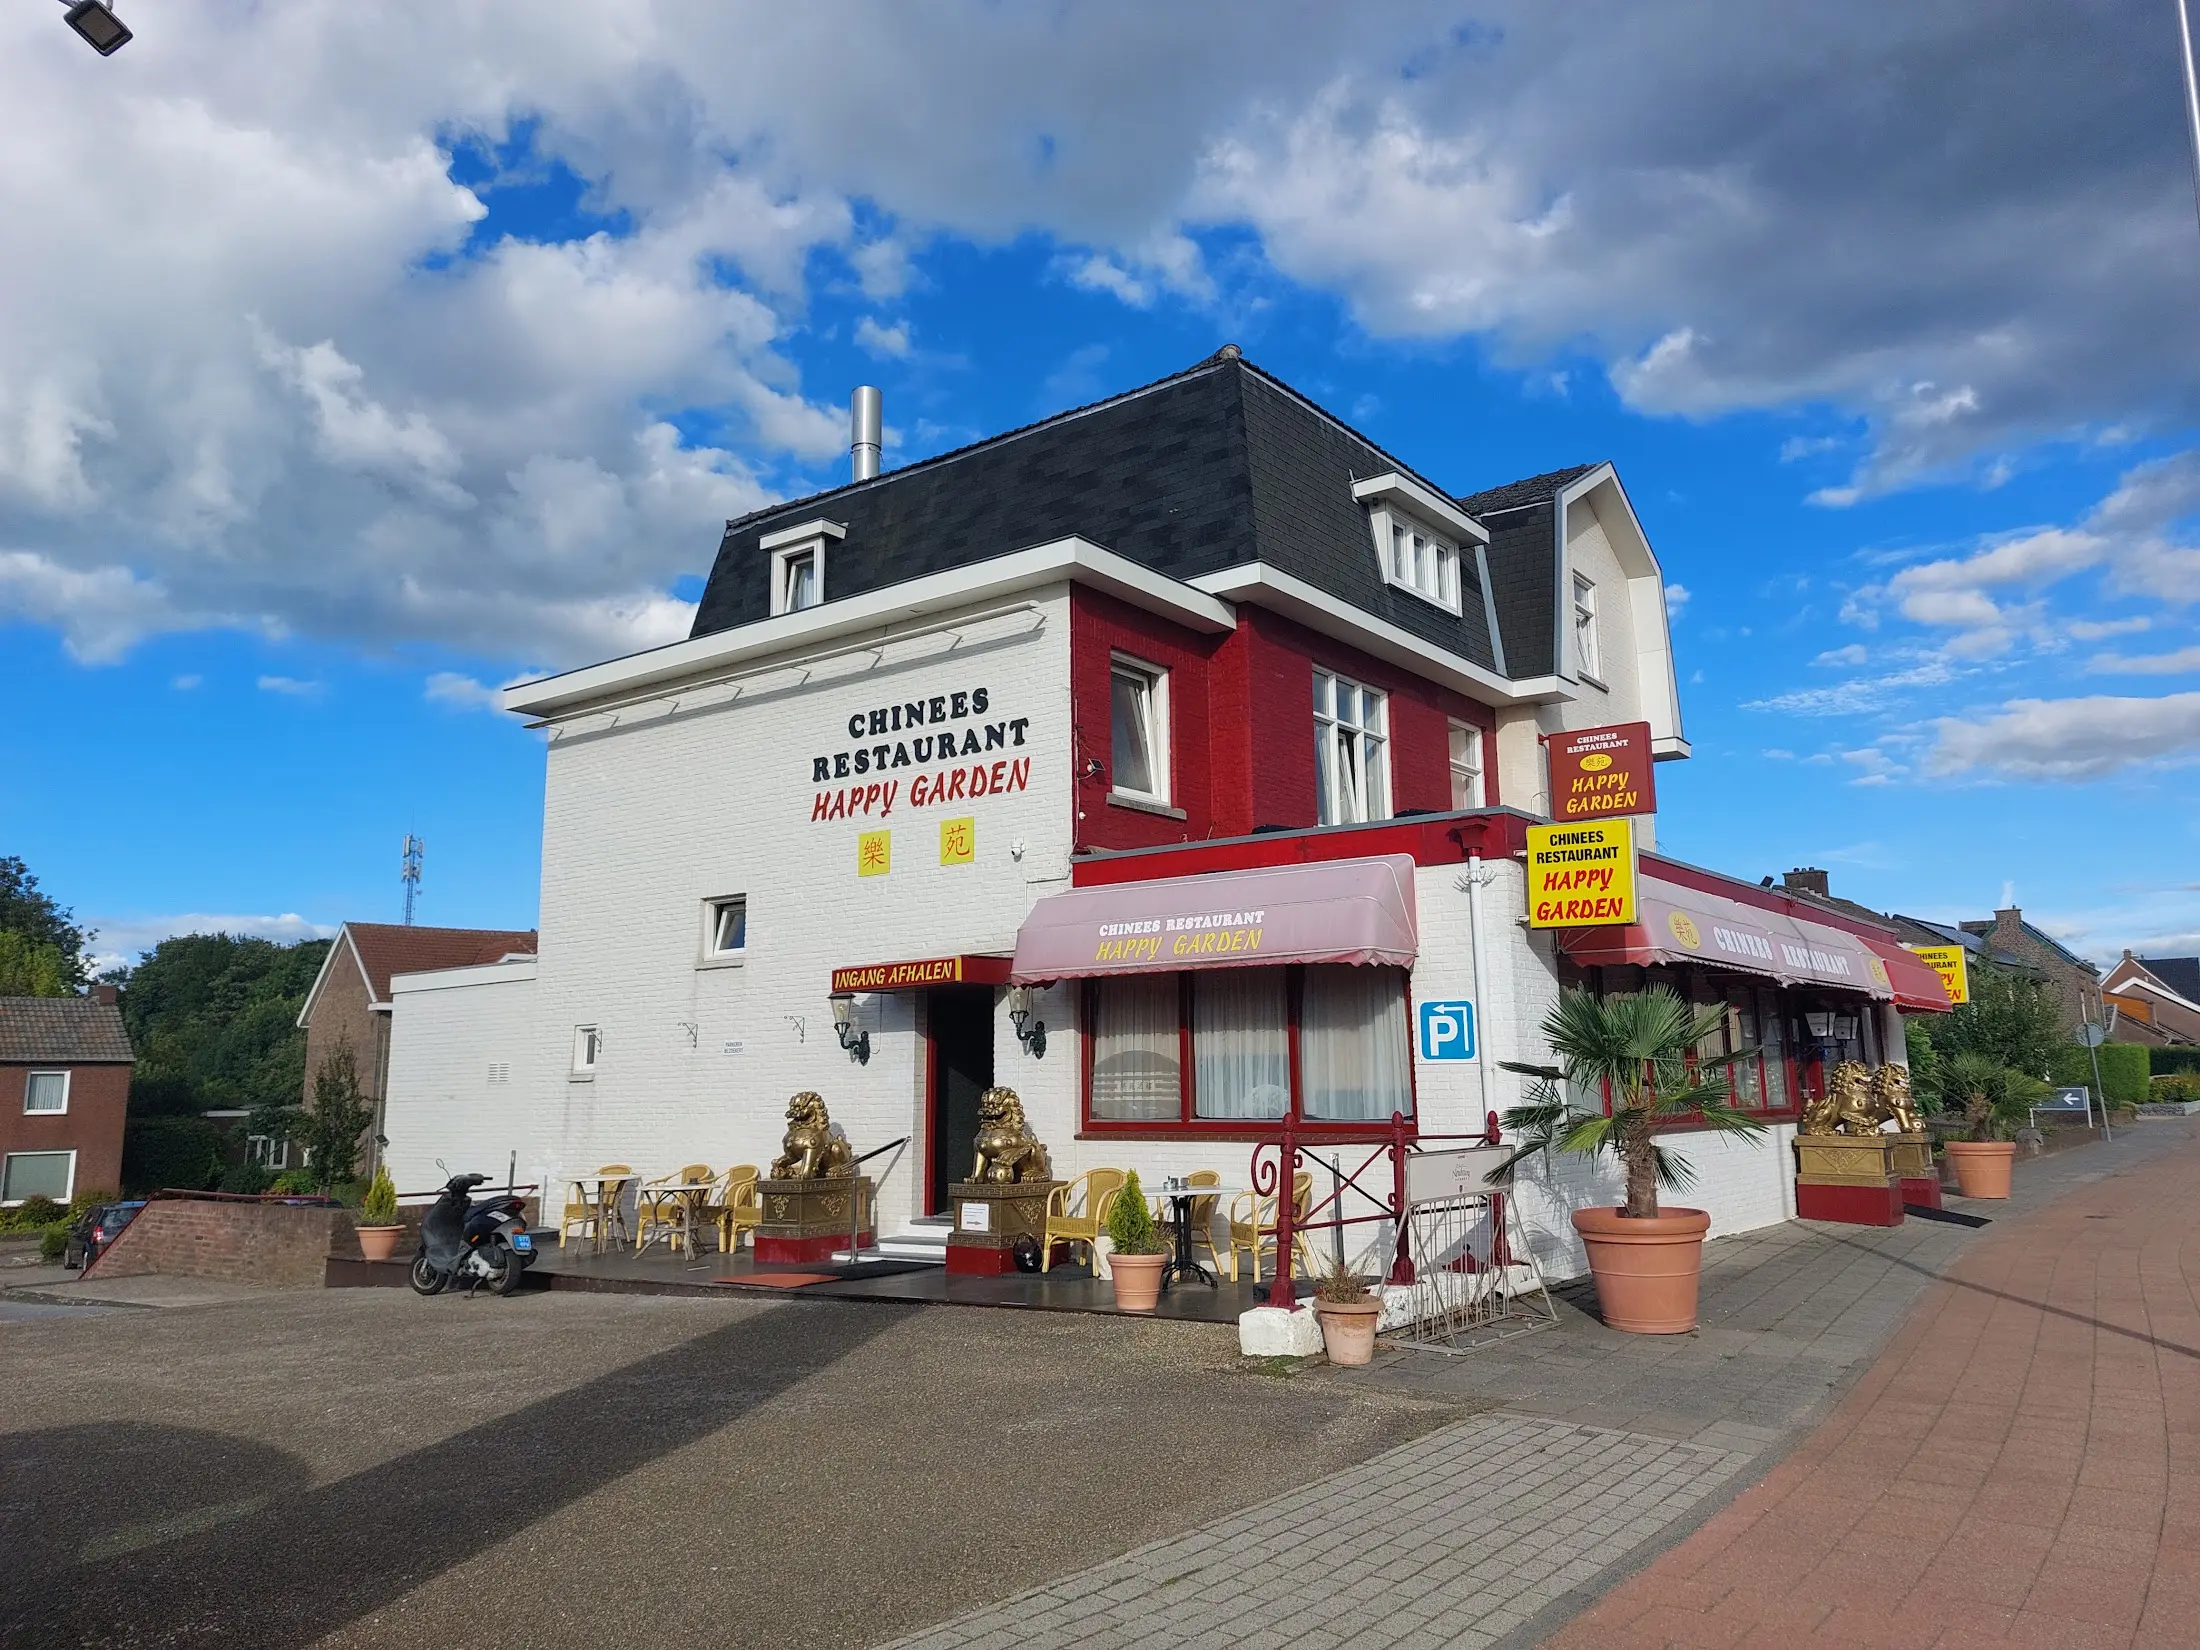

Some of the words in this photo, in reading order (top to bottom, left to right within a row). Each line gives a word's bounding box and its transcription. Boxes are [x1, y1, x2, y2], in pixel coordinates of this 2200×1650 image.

[848, 687, 989, 739] CHINEES
[812, 717, 1029, 782] RESTAURANT
[1566, 739, 1629, 754] RESTAURANT
[1576, 732, 1618, 744] CHINEES
[811, 779, 898, 822] HAPPY
[910, 756, 1030, 808] GARDEN
[1571, 771, 1629, 793] HAPPY
[1565, 791, 1637, 814] GARDEN
[863, 837, 885, 869] 樂
[944, 824, 970, 858] 苑
[1549, 830, 1604, 847] CHINEES
[1536, 846, 1619, 864] RESTAURANT
[1543, 867, 1614, 892] HAPPY
[1536, 897, 1623, 921] GARDEN
[1099, 919, 1161, 937] CHINEES
[1165, 911, 1265, 931] RESTAURANT
[1095, 935, 1163, 961] HAPPY
[1173, 928, 1263, 956] GARDEN
[1713, 926, 1773, 961] CHINEES
[1780, 943, 1851, 976] RESTAURANT
[1918, 952, 1948, 960] HINEES
[834, 968, 886, 989] INGANG
[888, 961, 953, 984] AFHALEN
[1428, 1015, 1459, 1057] P
